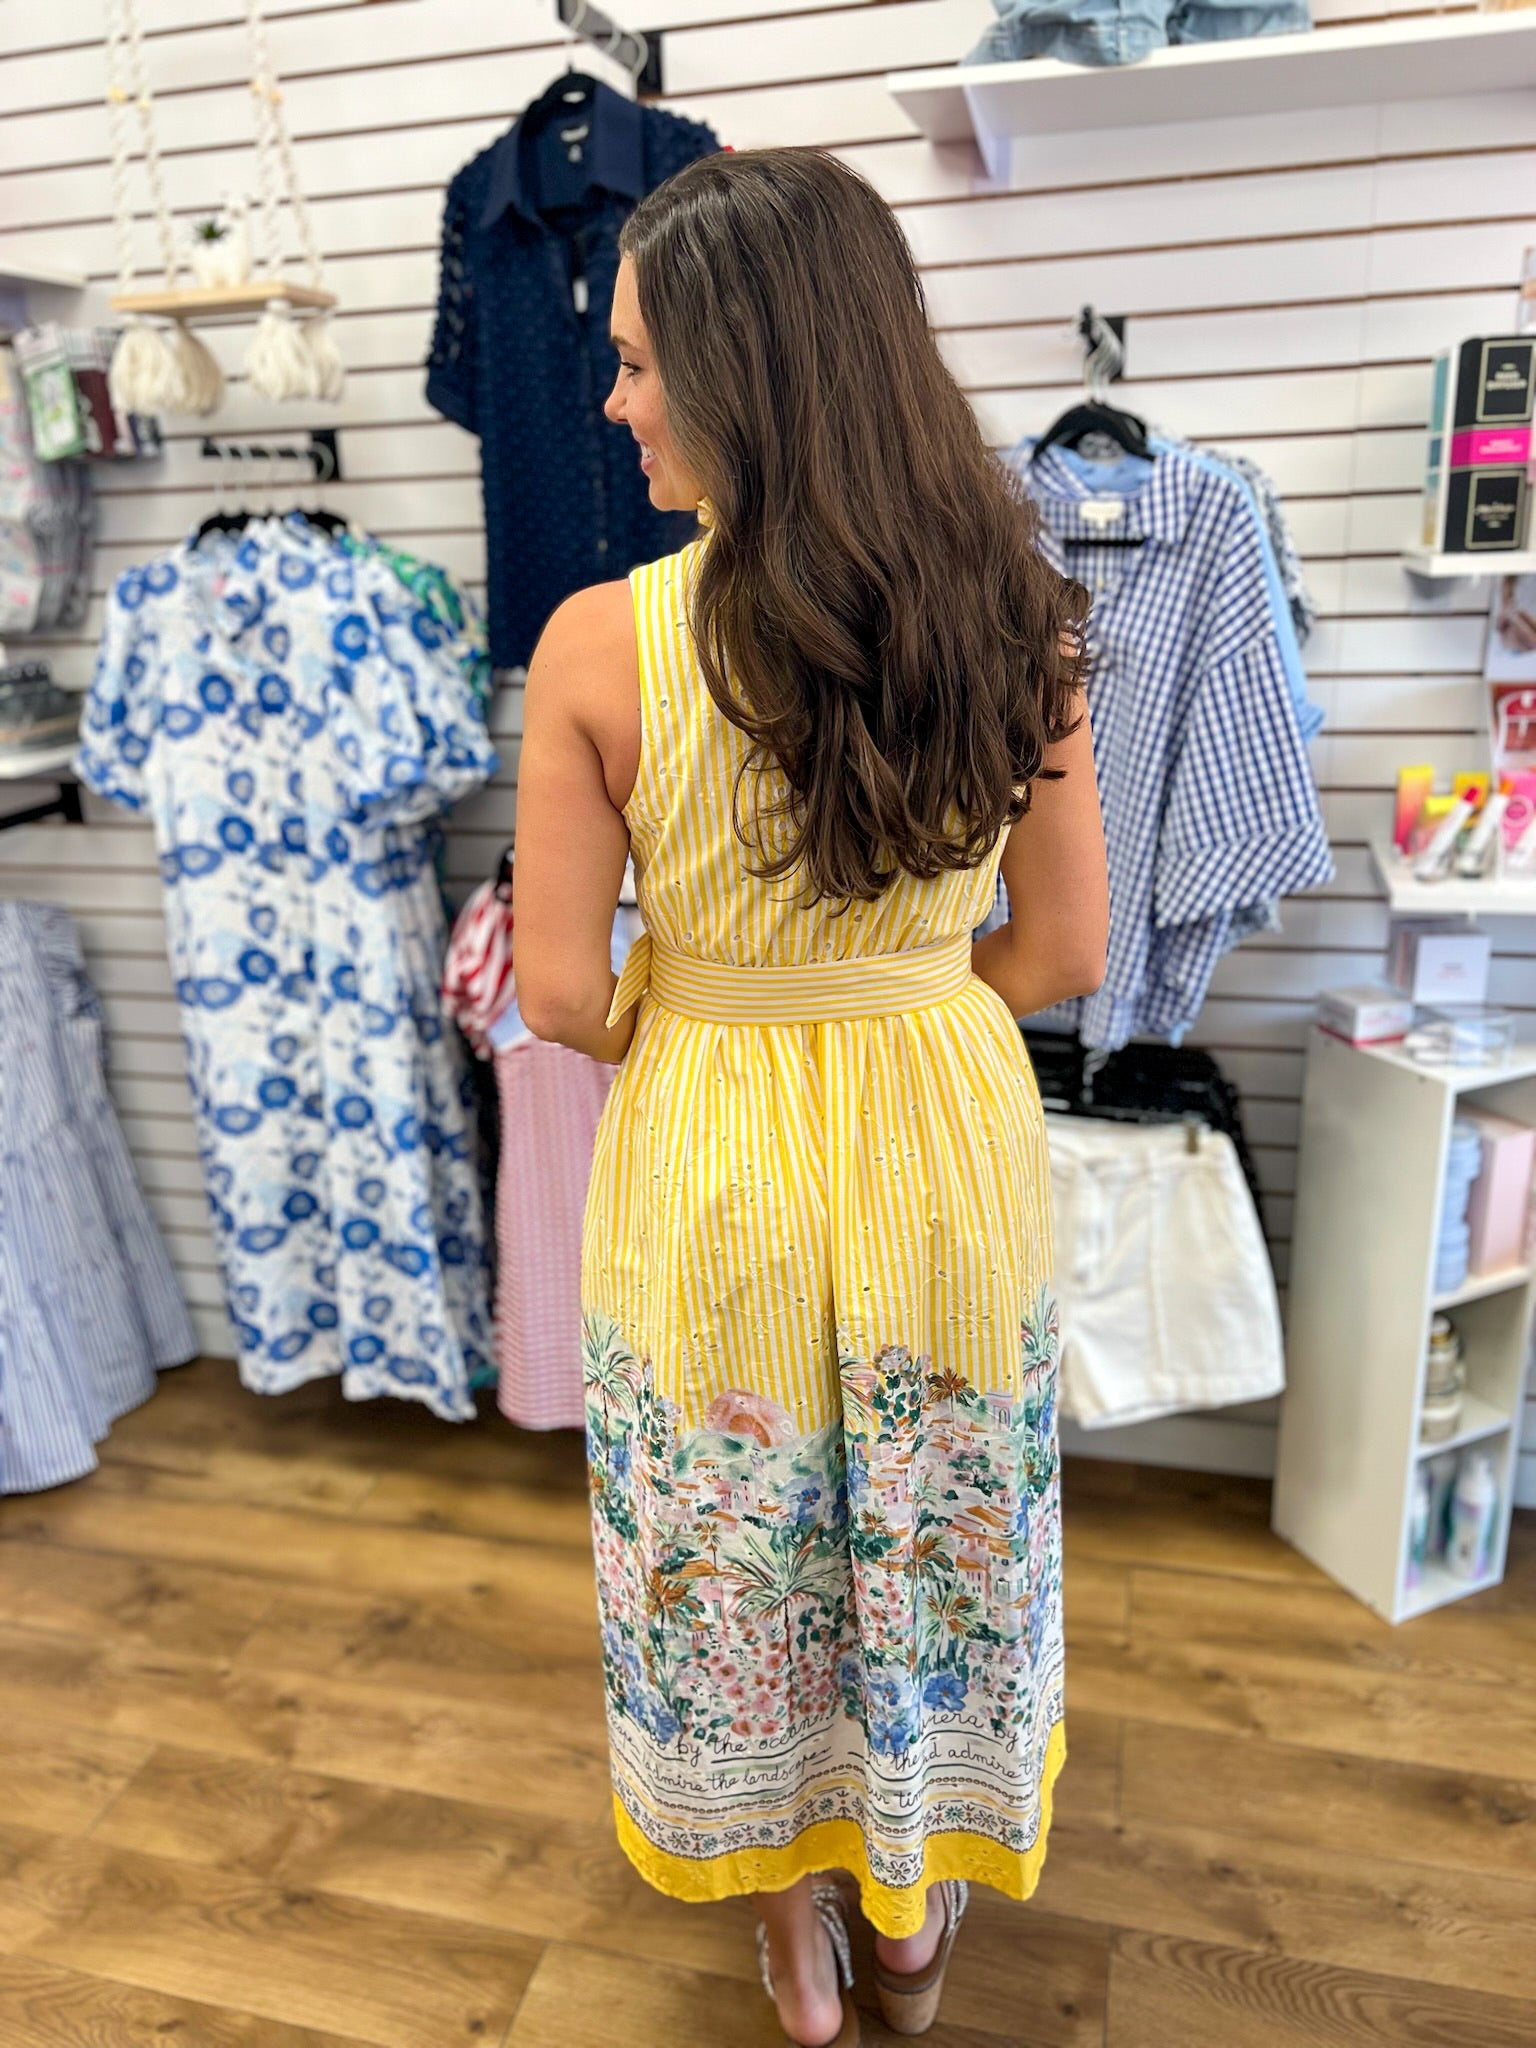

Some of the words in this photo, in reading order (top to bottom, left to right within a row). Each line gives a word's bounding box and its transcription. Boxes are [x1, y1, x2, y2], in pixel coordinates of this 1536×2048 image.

[675, 1733, 702, 1768] by
[710, 1732, 748, 1755] the
[993, 1722, 1019, 1753] by
[704, 1772, 739, 1791] the
[742, 1746, 831, 1786] landscape
[884, 1747, 918, 1772] the
[948, 1741, 1021, 1778] admire
